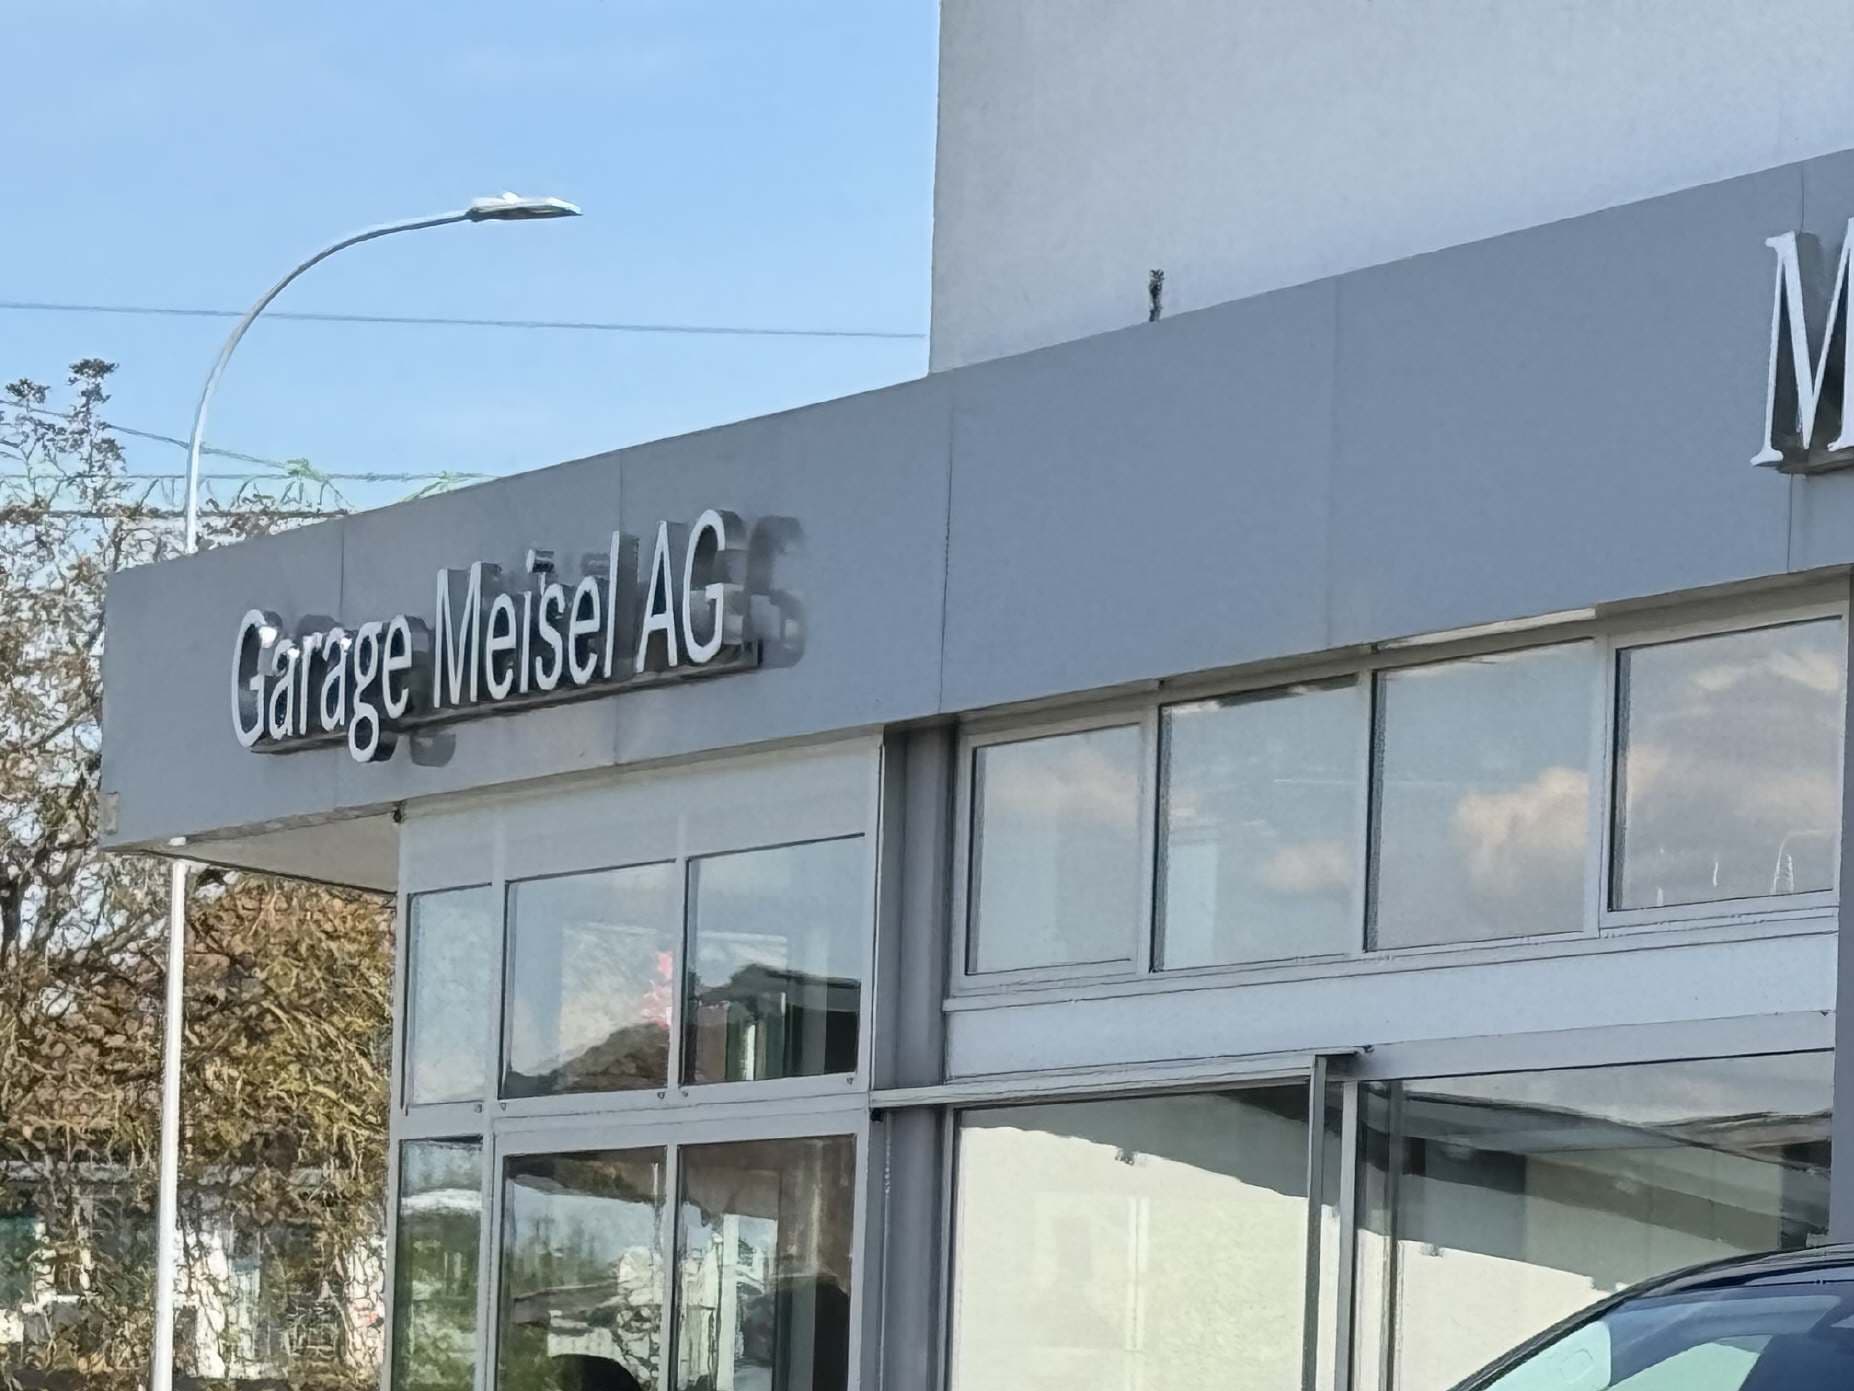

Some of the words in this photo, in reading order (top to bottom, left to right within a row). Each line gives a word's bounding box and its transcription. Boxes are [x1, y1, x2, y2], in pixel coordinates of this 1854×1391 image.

[231, 608, 413, 763] Garage
[433, 529, 620, 708] Meisel
[635, 507, 727, 674] AG
